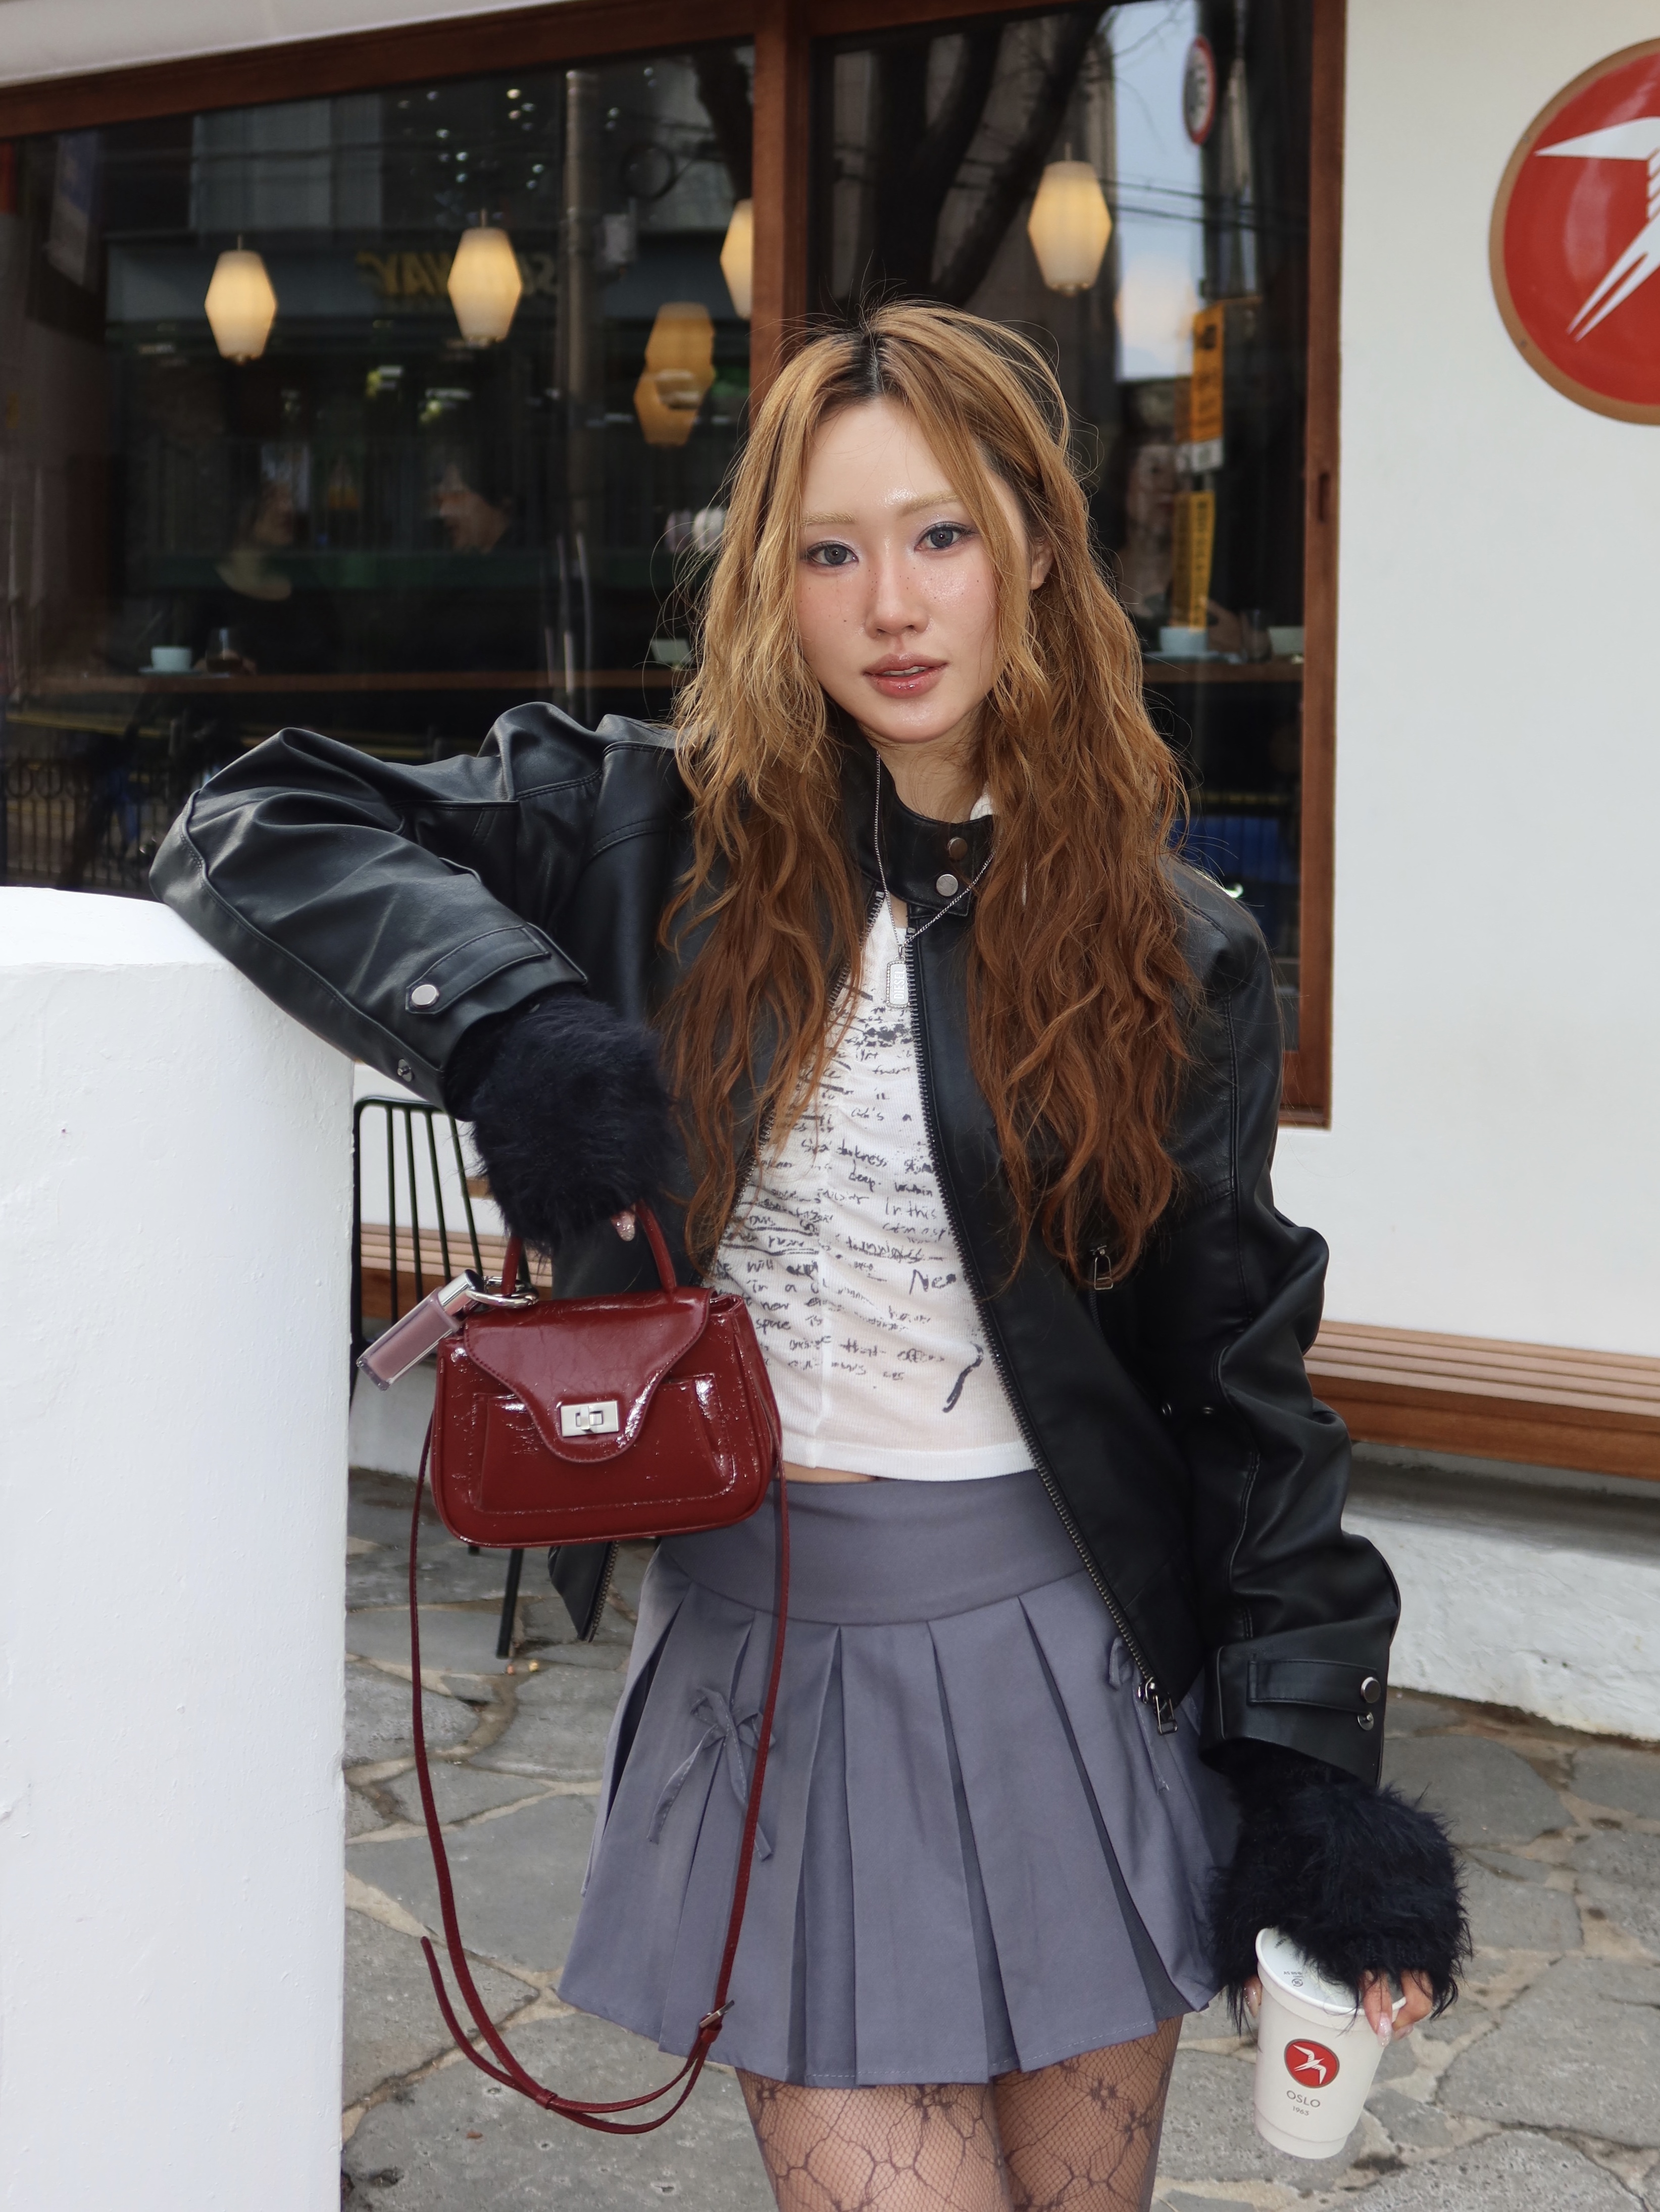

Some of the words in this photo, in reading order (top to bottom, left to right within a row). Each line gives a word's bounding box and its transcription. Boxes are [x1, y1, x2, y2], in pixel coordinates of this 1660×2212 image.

[893, 969, 906, 1000] DIESEL
[1286, 2090, 1321, 2108] OSLO
[1293, 2106, 1310, 2116] 1963
